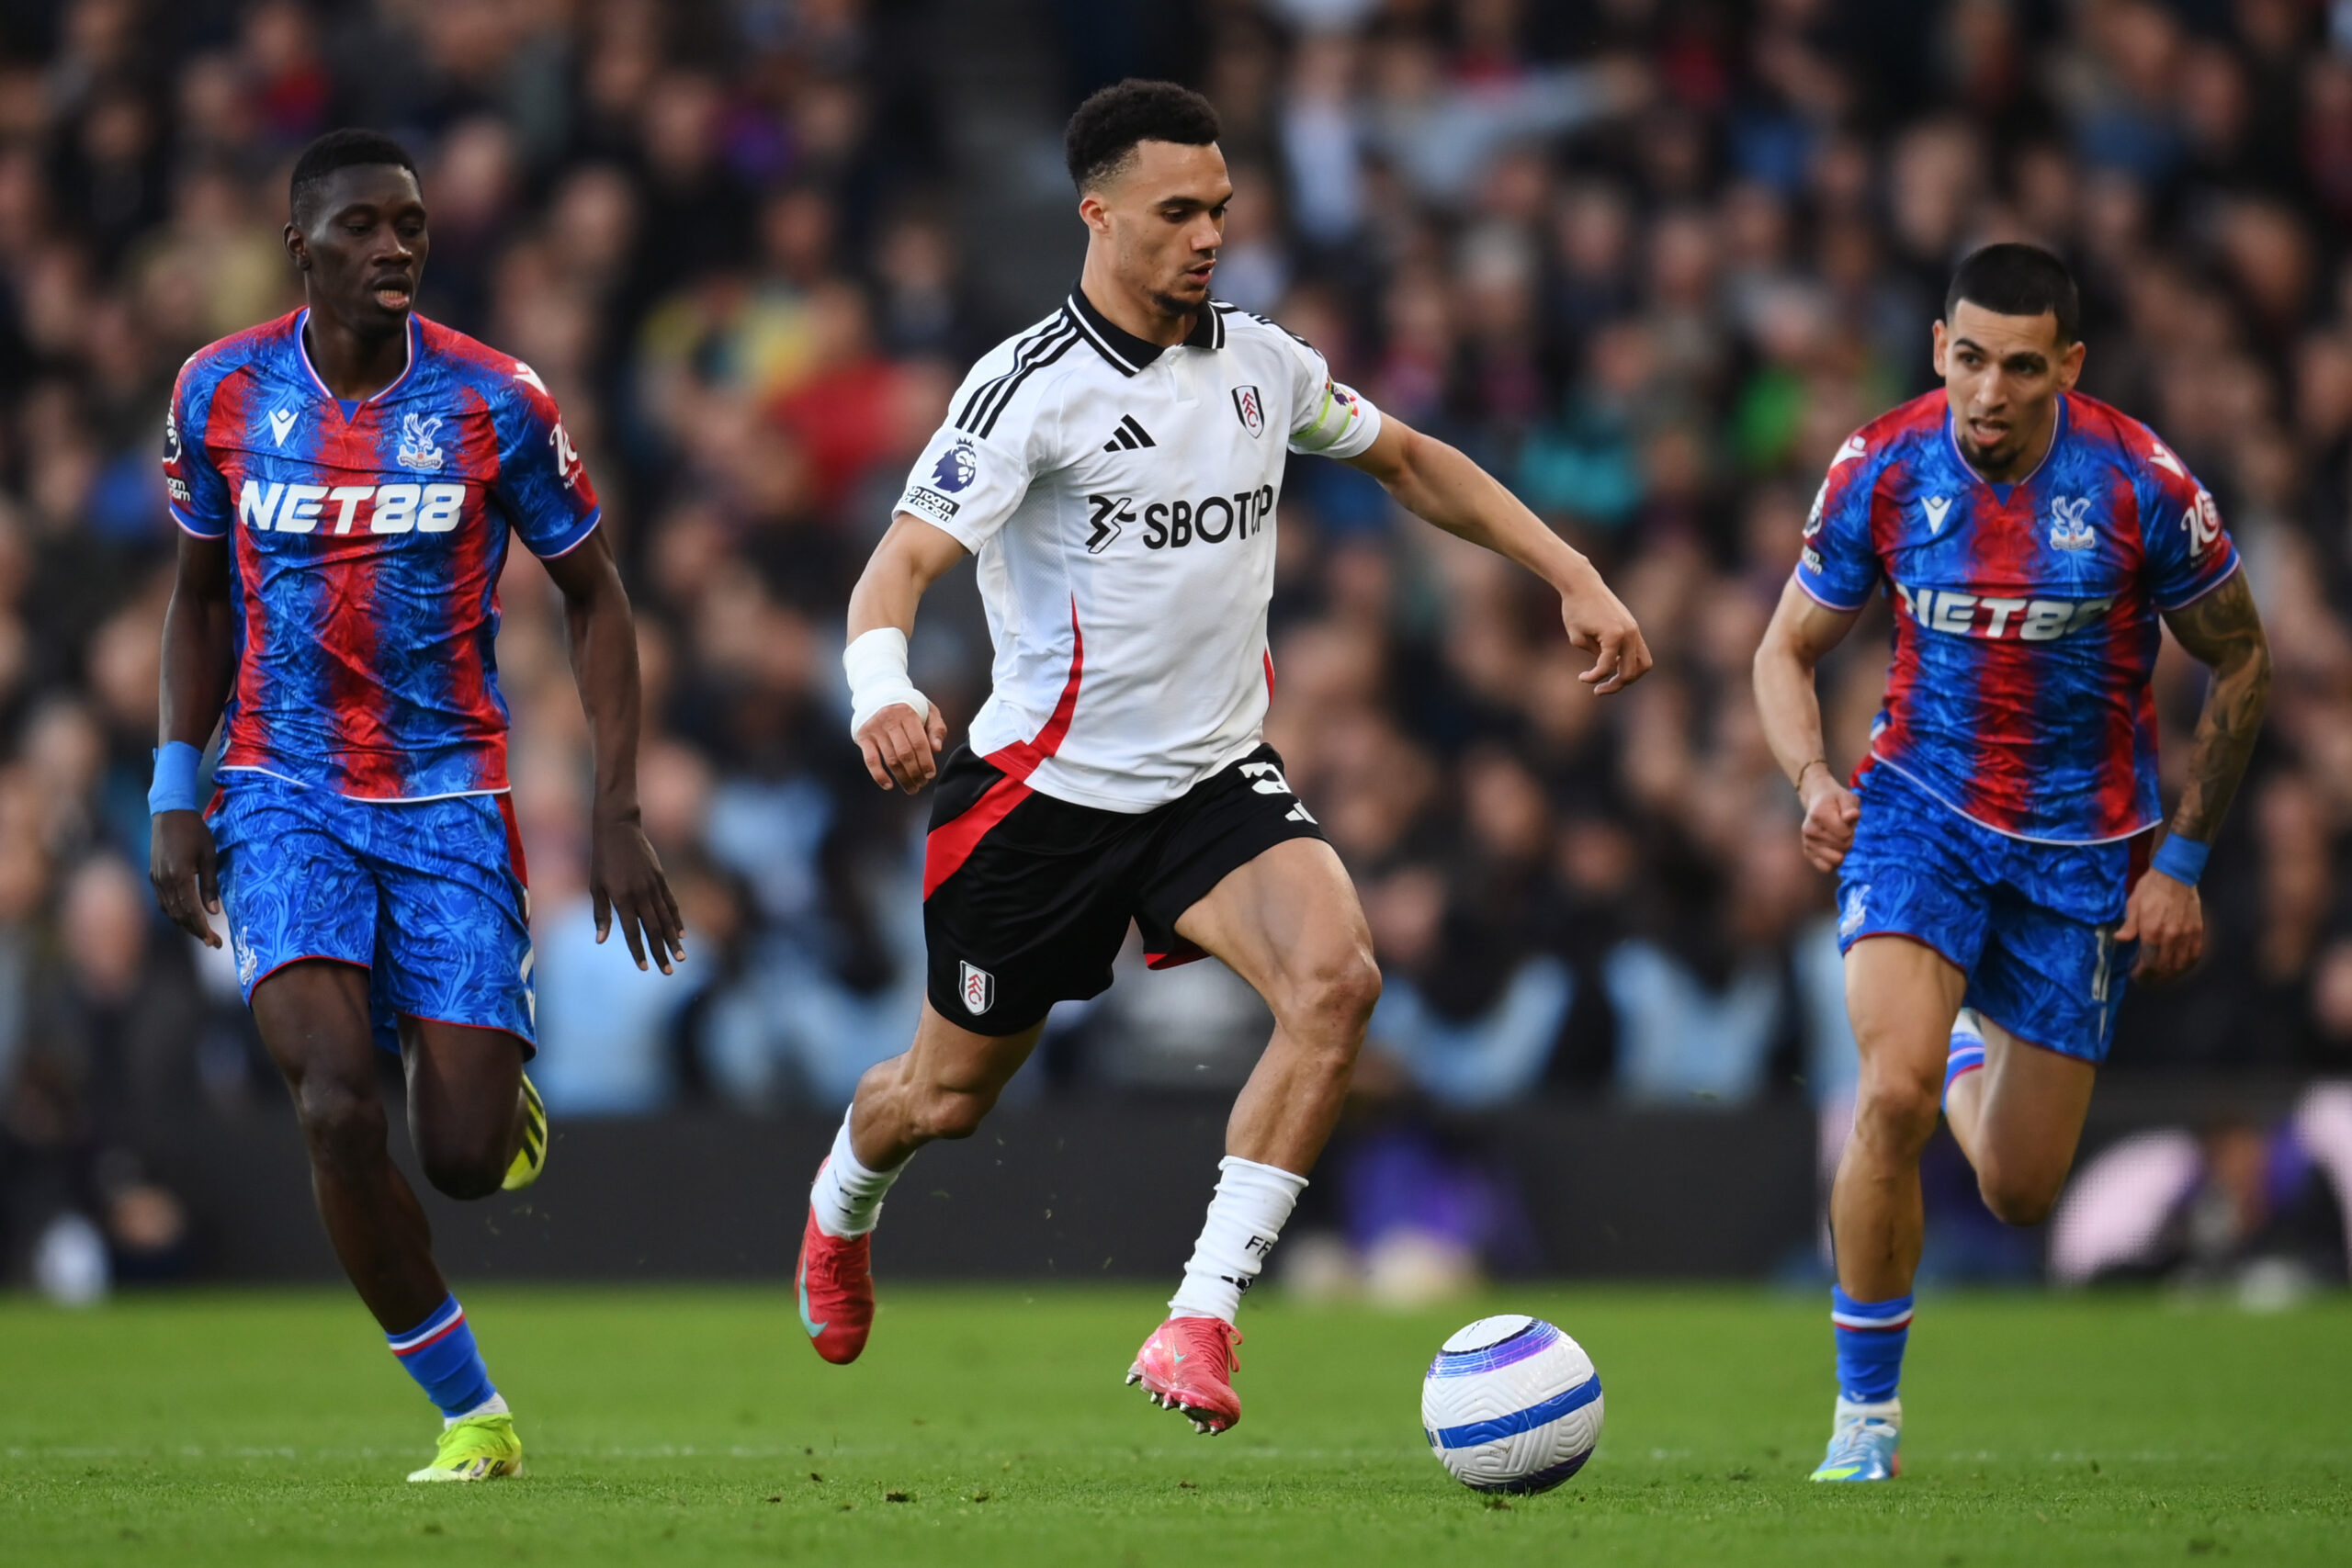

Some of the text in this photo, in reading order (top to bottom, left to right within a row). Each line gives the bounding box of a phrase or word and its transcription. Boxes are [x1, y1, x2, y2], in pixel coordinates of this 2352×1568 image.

[239, 479, 466, 535] NET88
[915, 498, 953, 523] racism
[920, 490, 954, 513] room
[967, 974, 983, 1005] FFC
